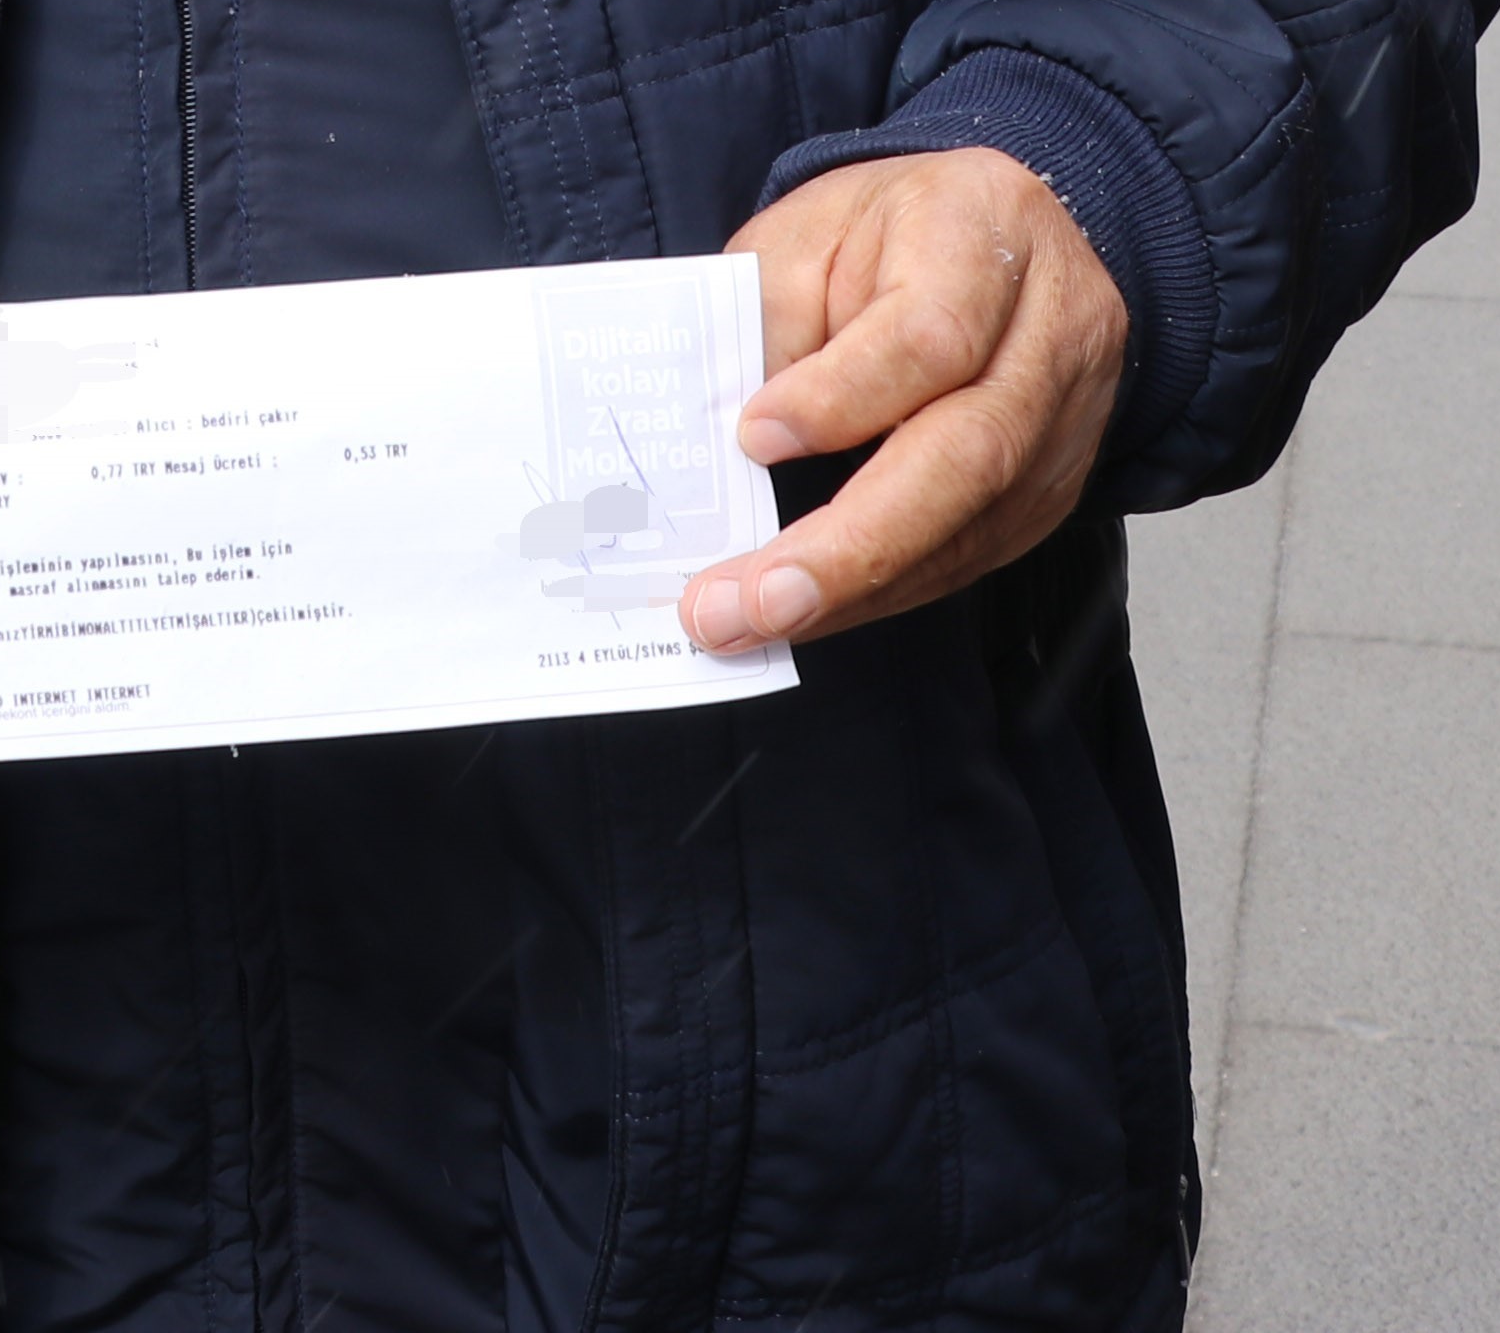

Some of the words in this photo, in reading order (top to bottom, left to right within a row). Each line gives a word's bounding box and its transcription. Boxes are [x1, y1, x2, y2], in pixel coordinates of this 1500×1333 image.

[563, 320, 692, 363] Dijitalin
[581, 364, 682, 399] kolayı
[91, 463, 123, 482] 0,77
[133, 461, 156, 476] TRY
[165, 456, 205, 476] Mesaj
[213, 452, 261, 470] Ücreti
[344, 445, 376, 464] 0,53
[384, 443, 408, 458] TRY
[0, 557, 72, 577] işleminin
[186, 547, 202, 562] Bu
[212, 544, 252, 562] işlem
[261, 540, 293, 558] için
[9, 579, 57, 598] masraf
[157, 571, 198, 589] talep
[13, 688, 77, 707] INTERNET
[87, 683, 151, 702] INTERNET
